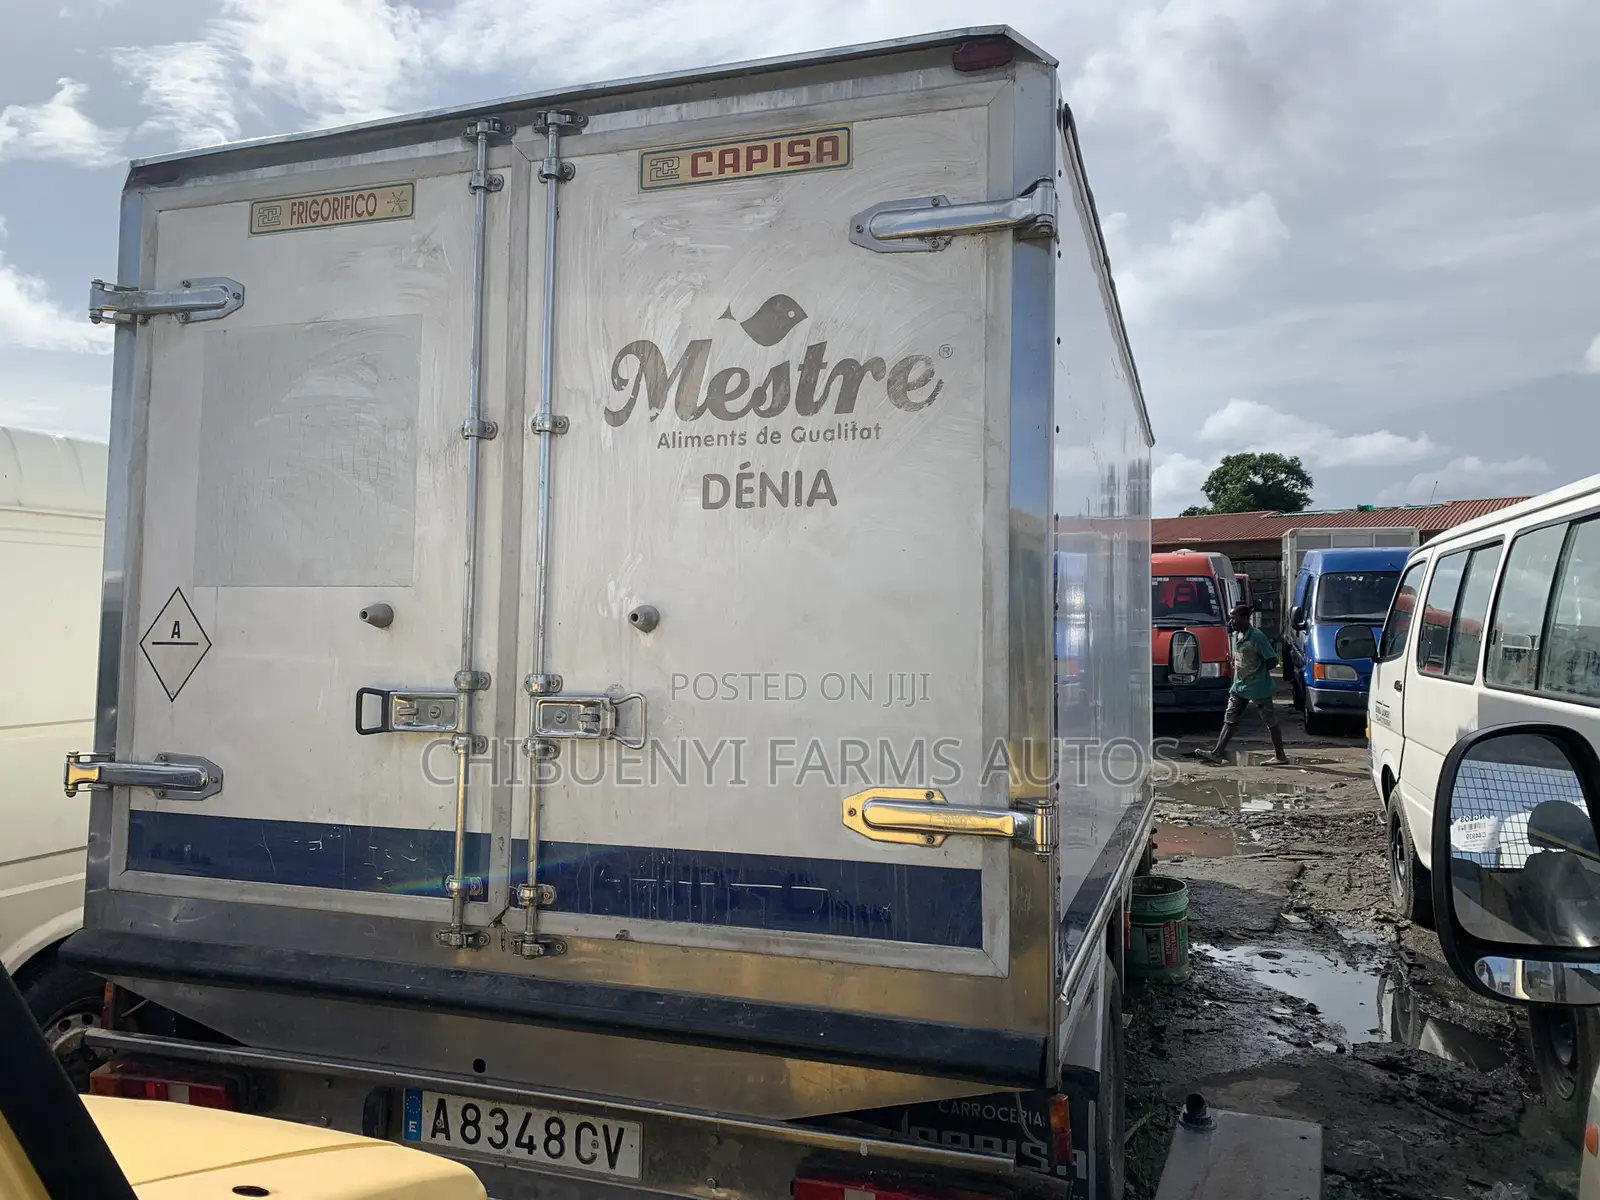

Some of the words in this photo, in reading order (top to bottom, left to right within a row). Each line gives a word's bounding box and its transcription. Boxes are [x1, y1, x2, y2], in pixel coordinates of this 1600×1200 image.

[691, 135, 839, 178] CAPISA
[290, 192, 377, 226] FRIGORIFICO
[604, 338, 945, 428] Mestre
[657, 429, 747, 450] Aliments
[756, 426, 782, 445] de
[790, 421, 883, 444] Qualitat
[702, 461, 838, 510] DÉNIA
[170, 620, 181, 639] A
[408, 1120, 417, 1133] E
[430, 1097, 625, 1170] A8348CV
